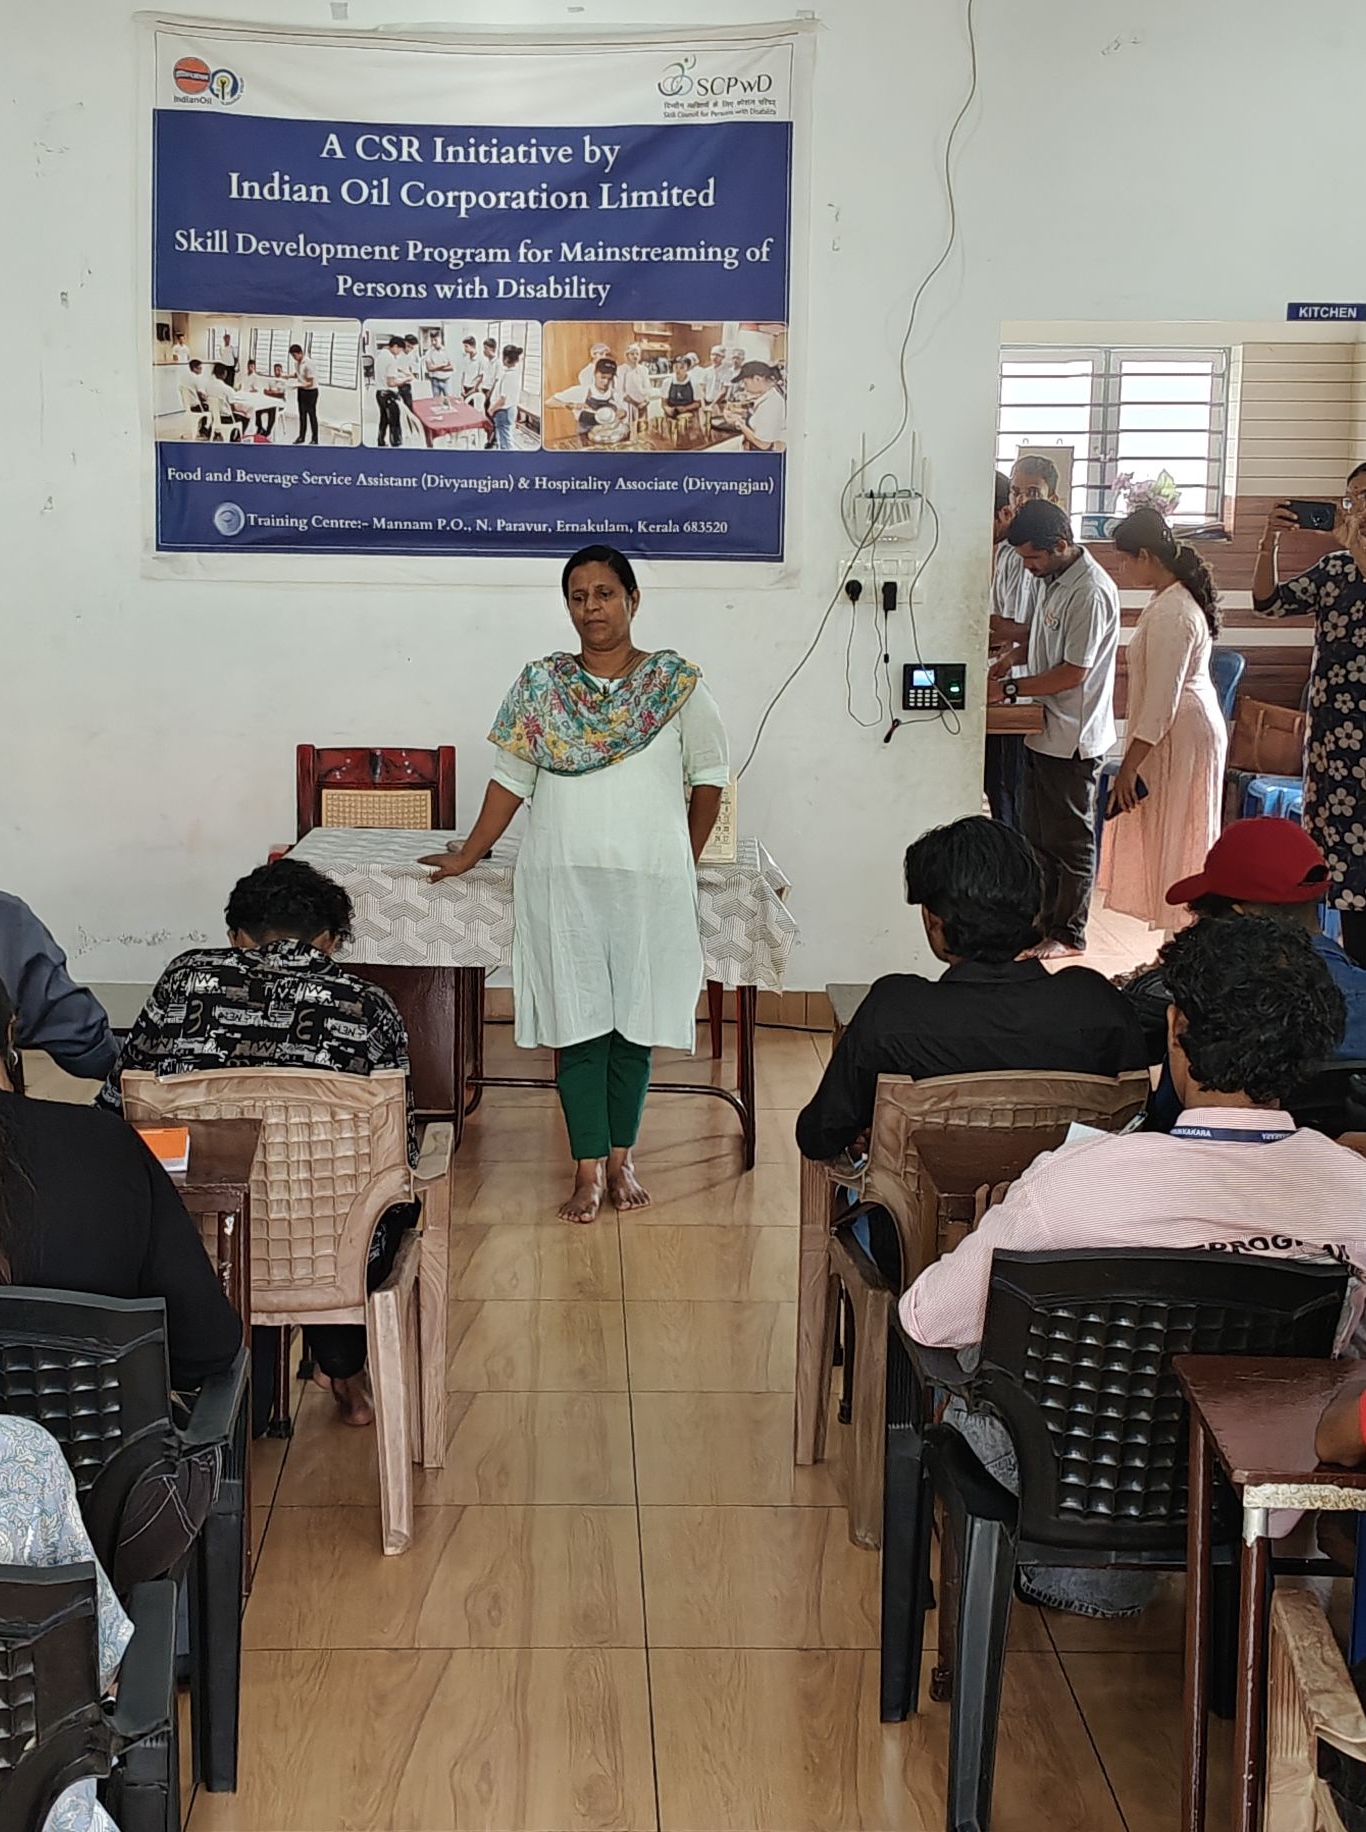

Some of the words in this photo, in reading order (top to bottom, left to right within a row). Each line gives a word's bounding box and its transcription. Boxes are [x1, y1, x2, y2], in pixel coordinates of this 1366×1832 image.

[696, 74, 773, 96] SCPwD
[173, 95, 213, 105] IndianOil
[319, 132, 347, 159] A
[354, 134, 423, 162] CSR
[432, 136, 574, 164] Initiative
[583, 134, 621, 174] by
[228, 171, 332, 204] Indian
[340, 176, 392, 207] Oil
[400, 180, 590, 218] Corporation
[598, 175, 716, 210] Limited
[174, 228, 230, 254] Skill
[235, 232, 400, 267] Development
[406, 239, 511, 270] Program
[517, 238, 553, 264] for
[559, 239, 740, 270] Mainstreaming
[745, 238, 774, 263] of
[335, 274, 428, 299] Persons
[434, 276, 489, 300] with
[496, 275, 612, 307] Disability
[1298, 306, 1358, 319] KITCHEN
[166, 467, 202, 482] Food
[204, 467, 233, 483] and
[235, 469, 300, 488] Beverage
[301, 471, 353, 486] Service
[355, 472, 418, 488] Assistant
[420, 473, 515, 494] (Divyangjan)
[517, 476, 531, 490] &
[534, 475, 611, 495] Hospitality
[614, 477, 679, 492] Associate
[682, 476, 775, 495] (Divyangjan)
[246, 513, 309, 531] Training
[311, 514, 370, 529] Centre:-
[372, 517, 433, 531] Mannam
[436, 518, 473, 533] P.O.,
[475, 519, 493, 531] N.
[496, 519, 552, 534] Paravur,
[556, 518, 634, 535] Ernakulam,
[637, 519, 680, 533] Kerala
[682, 520, 729, 534] 683520
